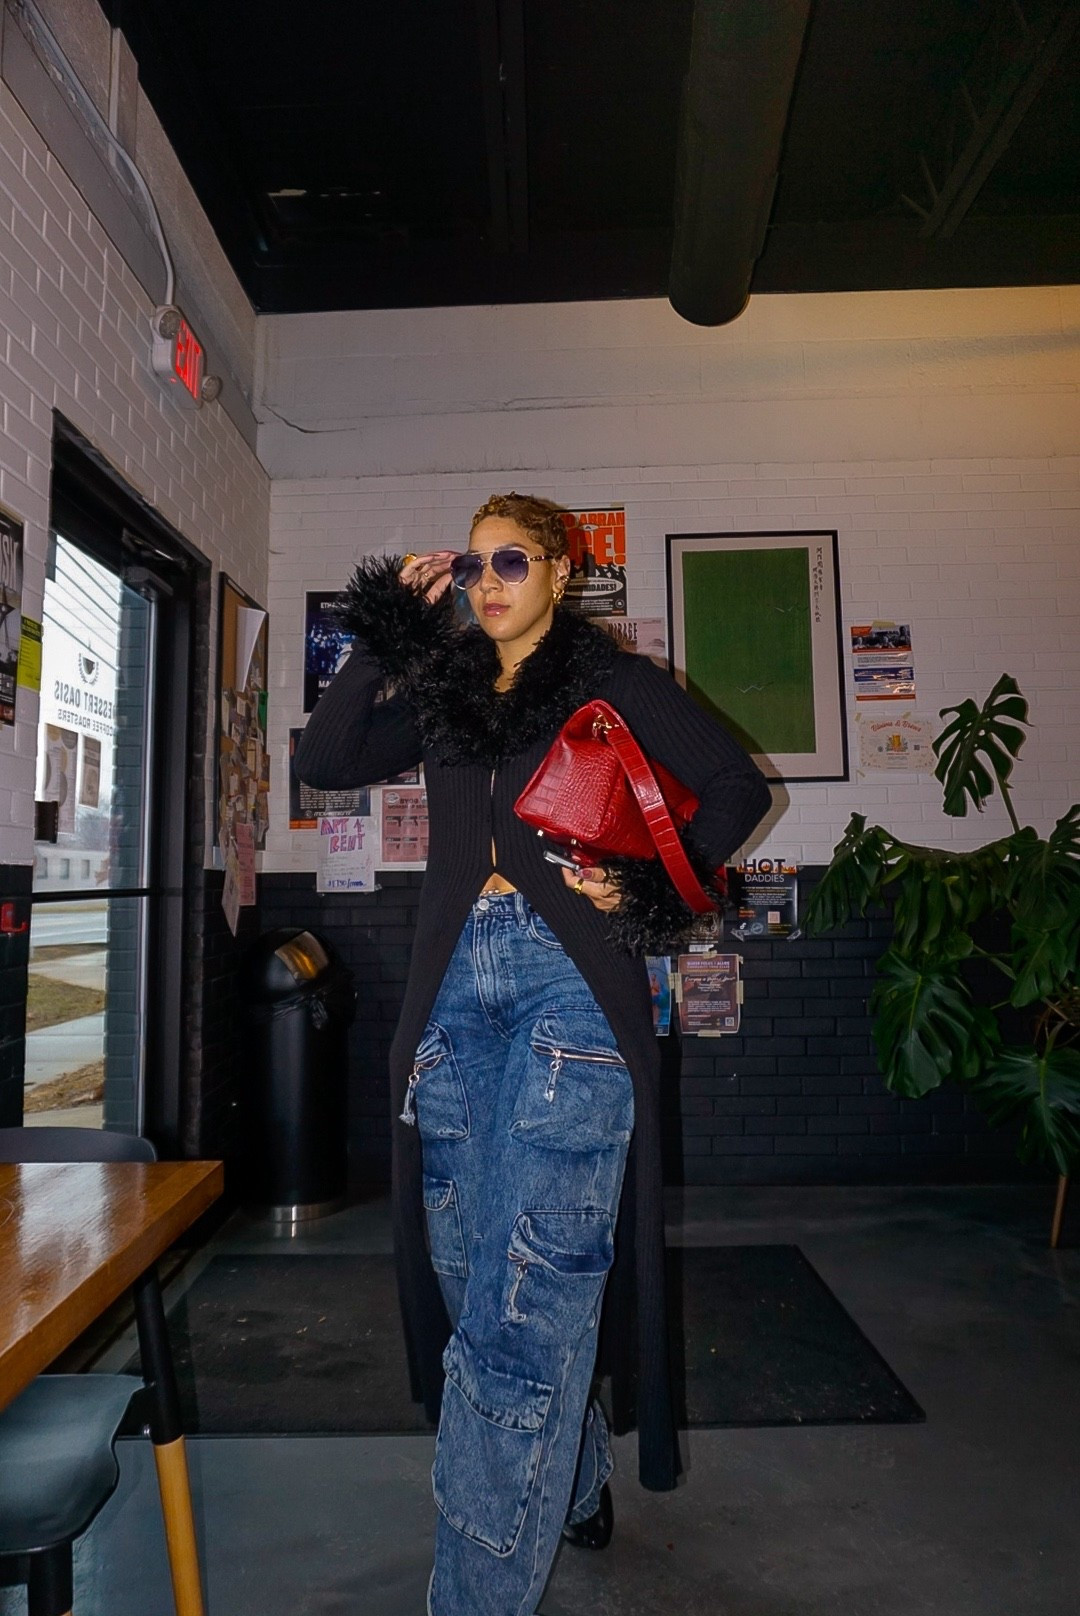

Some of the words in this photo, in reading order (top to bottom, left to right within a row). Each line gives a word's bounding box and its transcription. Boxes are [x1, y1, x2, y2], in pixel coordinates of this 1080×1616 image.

[329, 831, 366, 854] RENT
[743, 858, 786, 873] HOT
[744, 873, 785, 883] DADDIES
